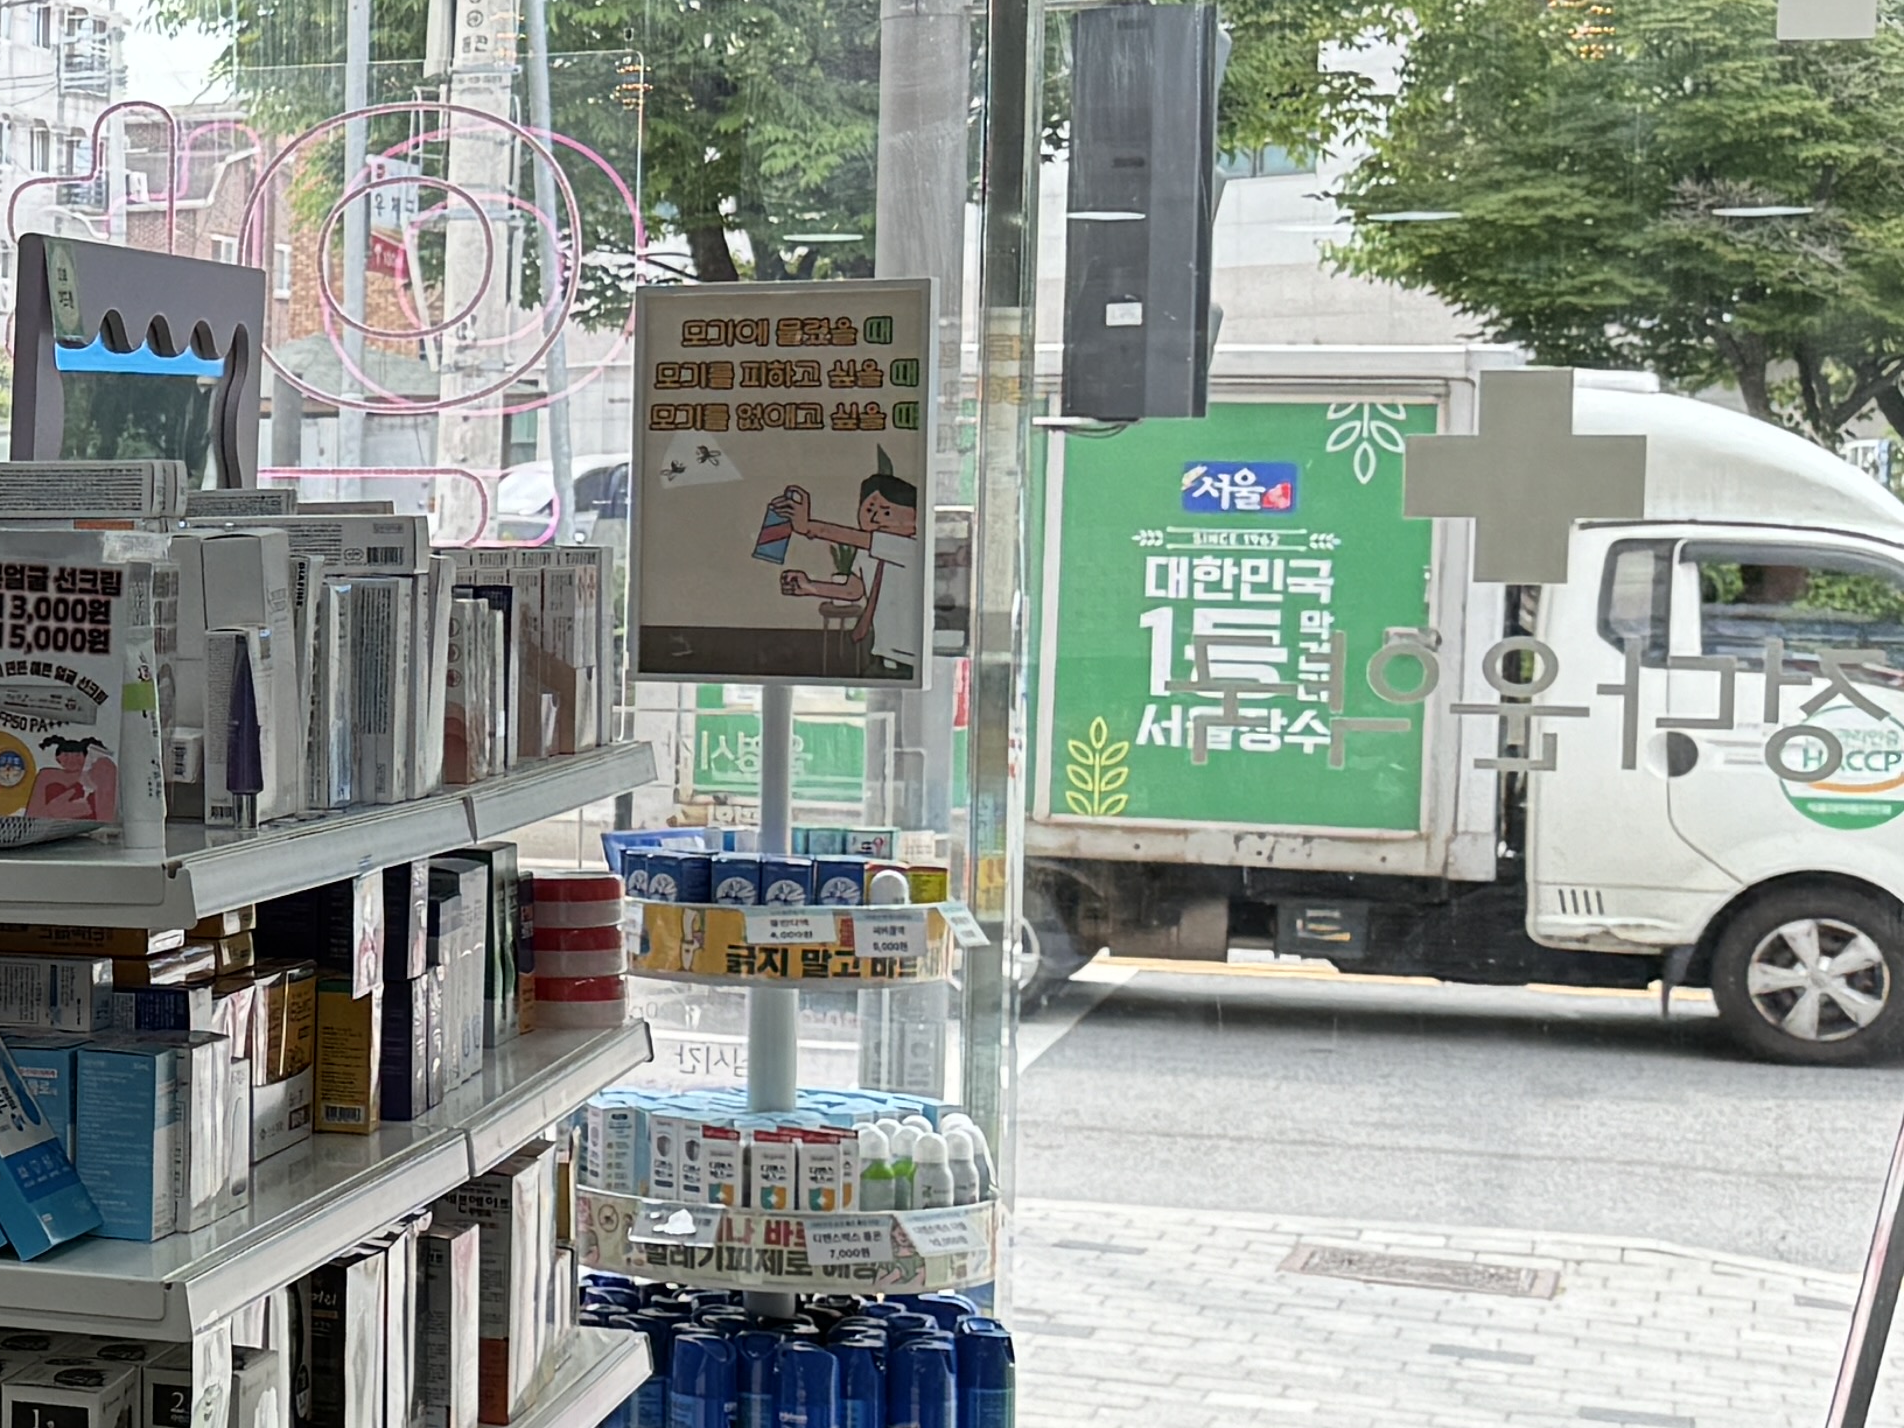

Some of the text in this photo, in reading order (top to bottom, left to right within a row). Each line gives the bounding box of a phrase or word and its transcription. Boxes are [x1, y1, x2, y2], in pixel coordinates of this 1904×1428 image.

[682, 316, 893, 347] 모기에 물렸을 때
[654, 358, 919, 389] 모기를 피하고 싶을 때
[649, 401, 919, 431] 모기를 없애고 싶을 때
[1192, 467, 1266, 510] 서울
[1193, 533, 1280, 546] SINCE 1962
[53, 566, 122, 597] 선크림
[1145, 555, 1335, 604] 대한민국
[9, 594, 111, 625] 3,000원
[8, 623, 111, 655] 5,000원
[1139, 606, 1288, 699] 1등
[725, 944, 789, 978] 긁지
[800, 946, 861, 979] 말고
